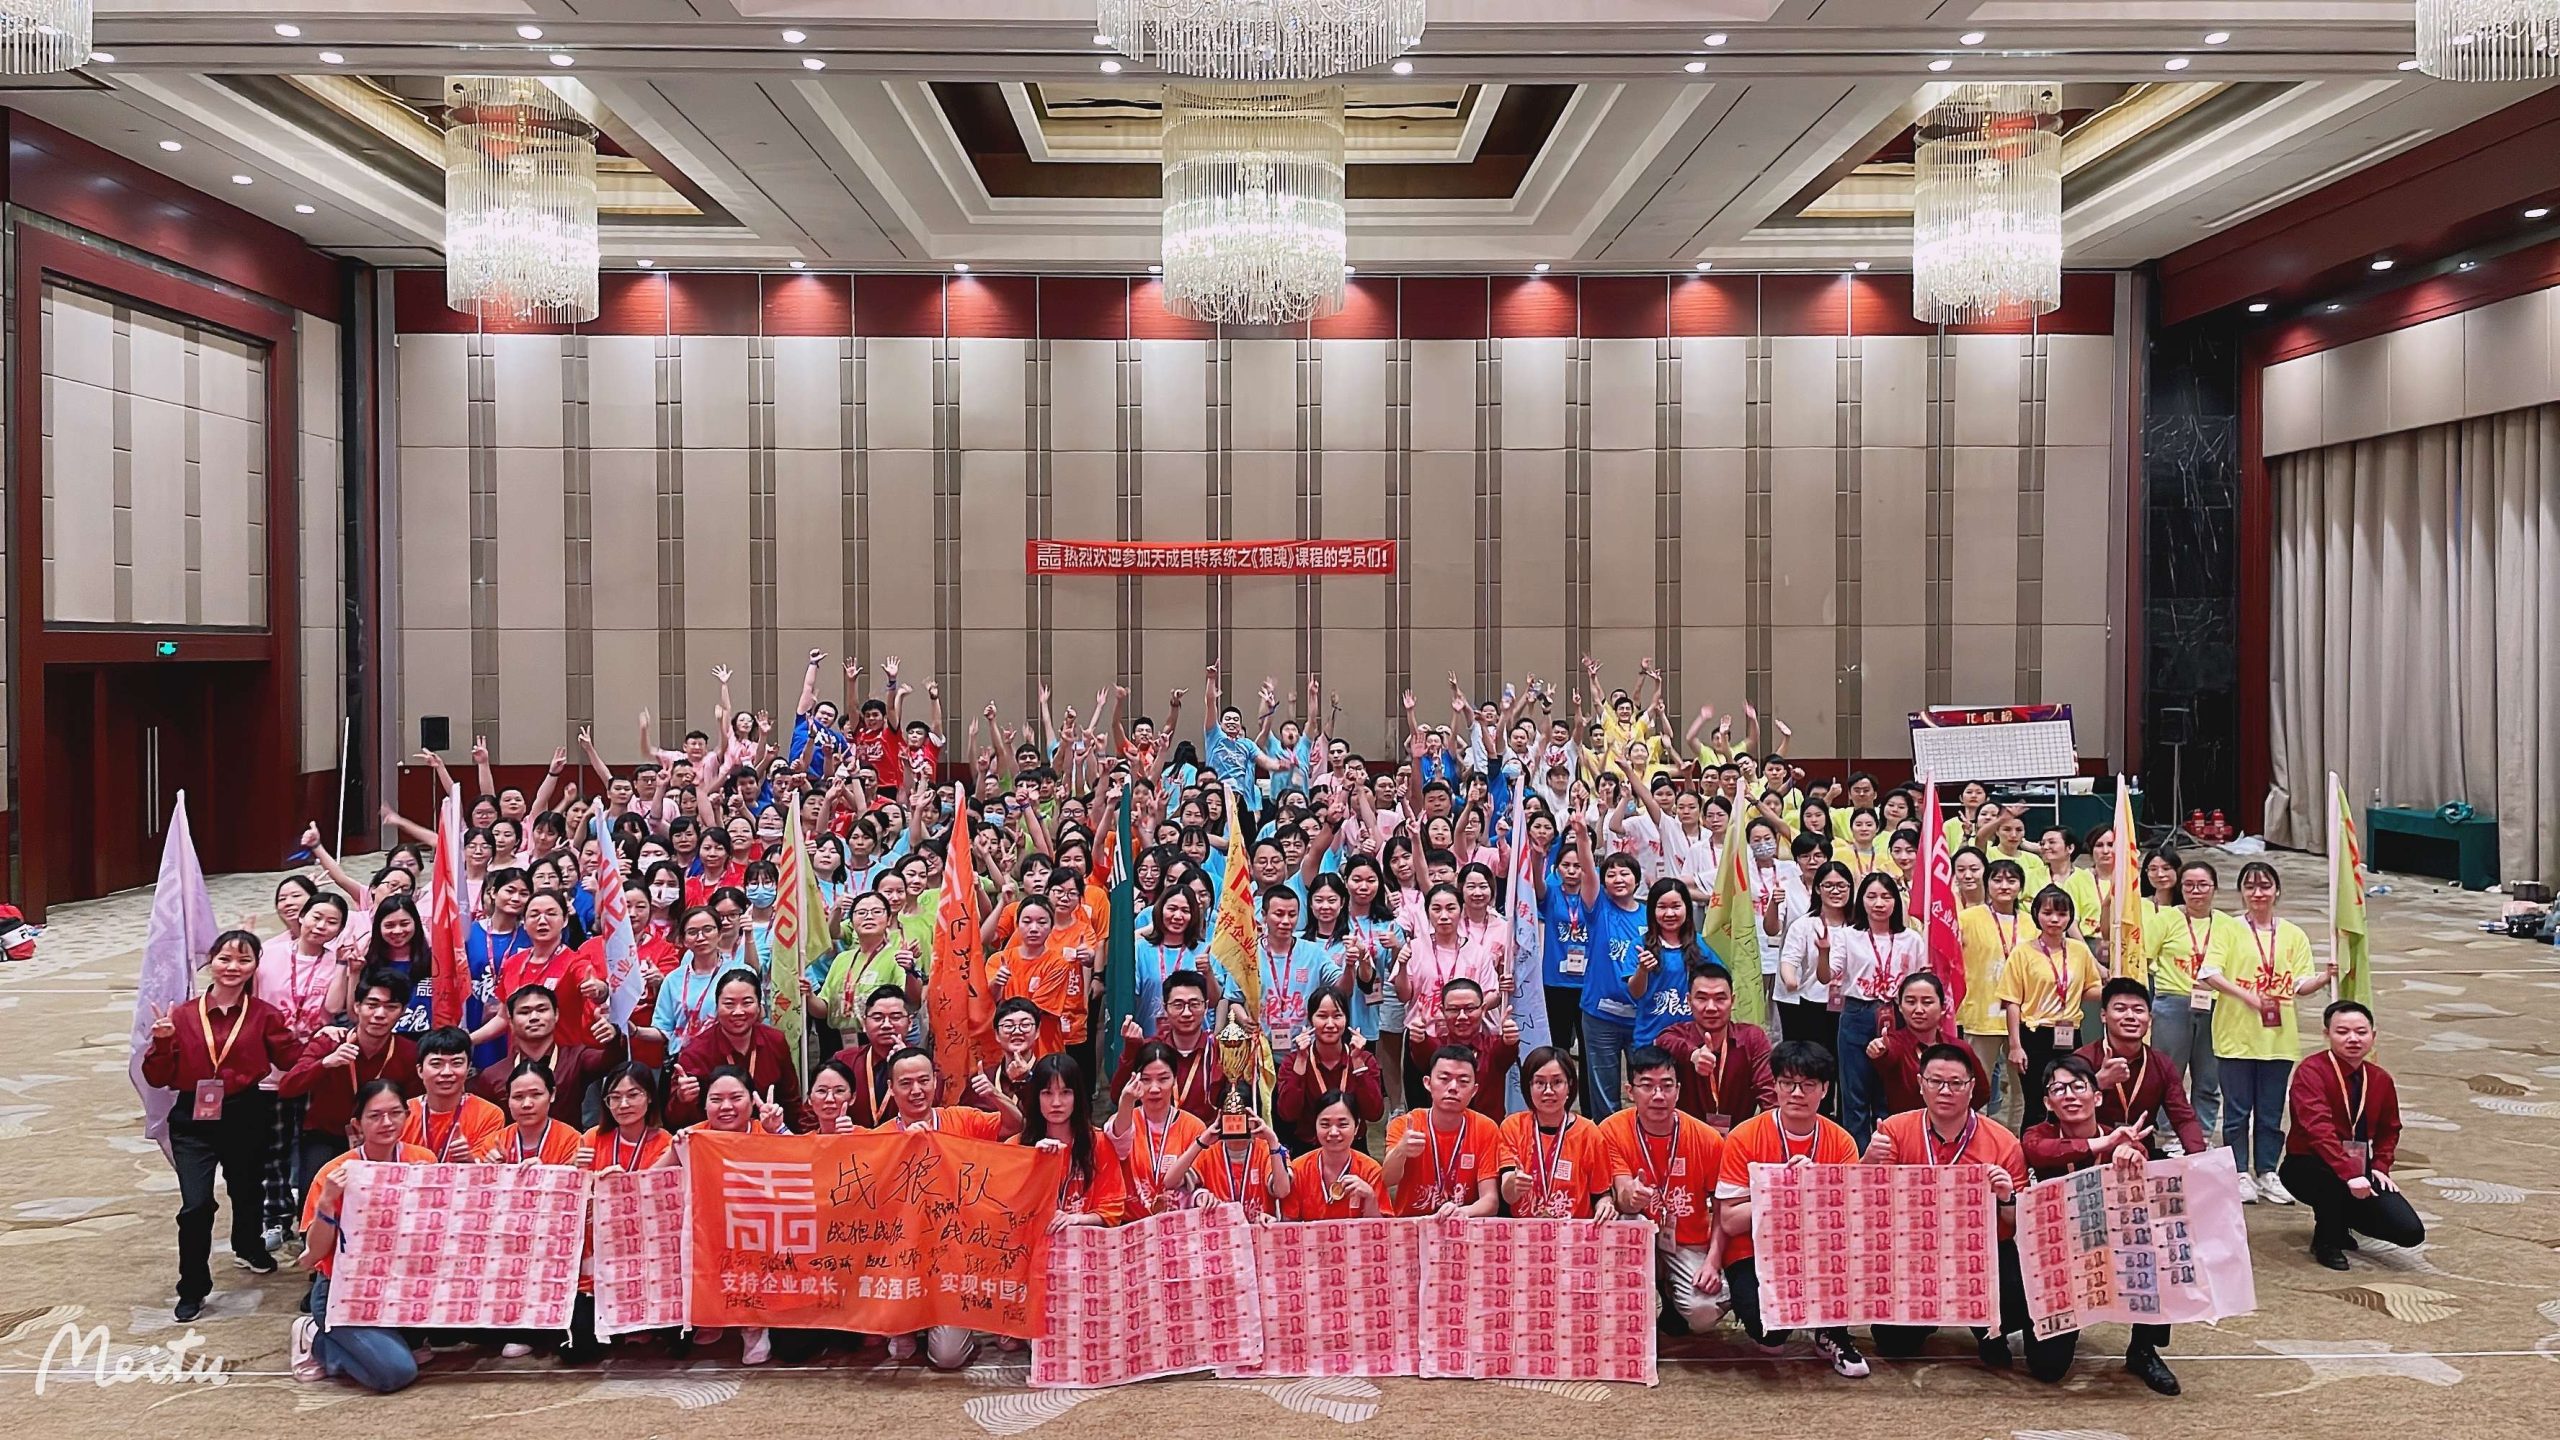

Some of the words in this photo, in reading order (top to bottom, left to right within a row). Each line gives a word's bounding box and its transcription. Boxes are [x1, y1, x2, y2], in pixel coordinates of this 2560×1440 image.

[1063, 546, 1389, 570] 热烈欢迎参加天成自转系统之《狼魂》课程的学员们！
[830, 1147, 1008, 1209] 战狼队
